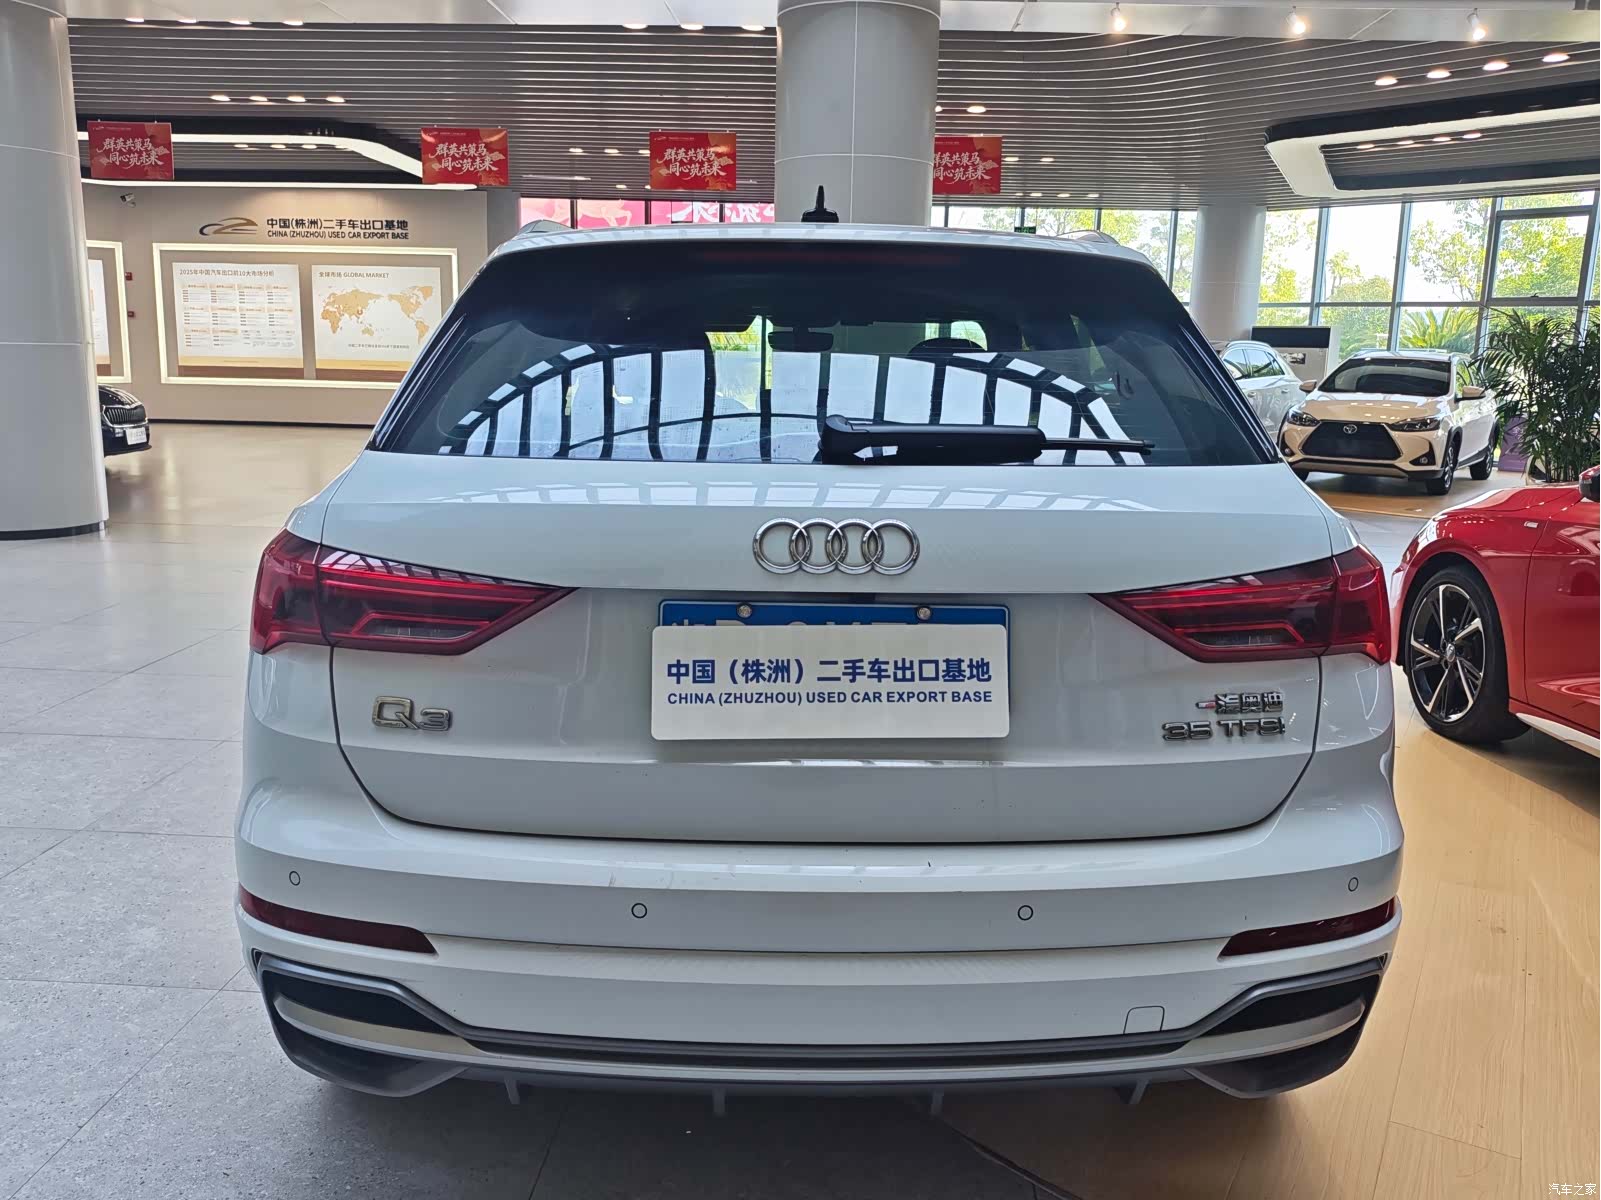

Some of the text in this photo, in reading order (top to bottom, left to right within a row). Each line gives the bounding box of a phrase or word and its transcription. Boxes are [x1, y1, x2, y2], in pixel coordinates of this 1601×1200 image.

[96, 137, 153, 153] 群英共策马
[429, 142, 488, 158] 群英共策马
[109, 151, 164, 169] 同心筑未来
[656, 147, 716, 164] 群英共策马
[441, 156, 499, 175] 同心筑未来
[669, 161, 728, 180] 同心筑未来
[267, 230, 410, 240] CHINA (ZHUZHOU) USED CAR EXPORT BASE
[667, 691, 993, 706] CHINA (ZHUZHOU) USED CAR EXPORT BASE
[1196, 692, 1284, 715] 一汽奥迪
[372, 695, 453, 732] Q3
[1162, 716, 1286, 741] 35 TFSI
